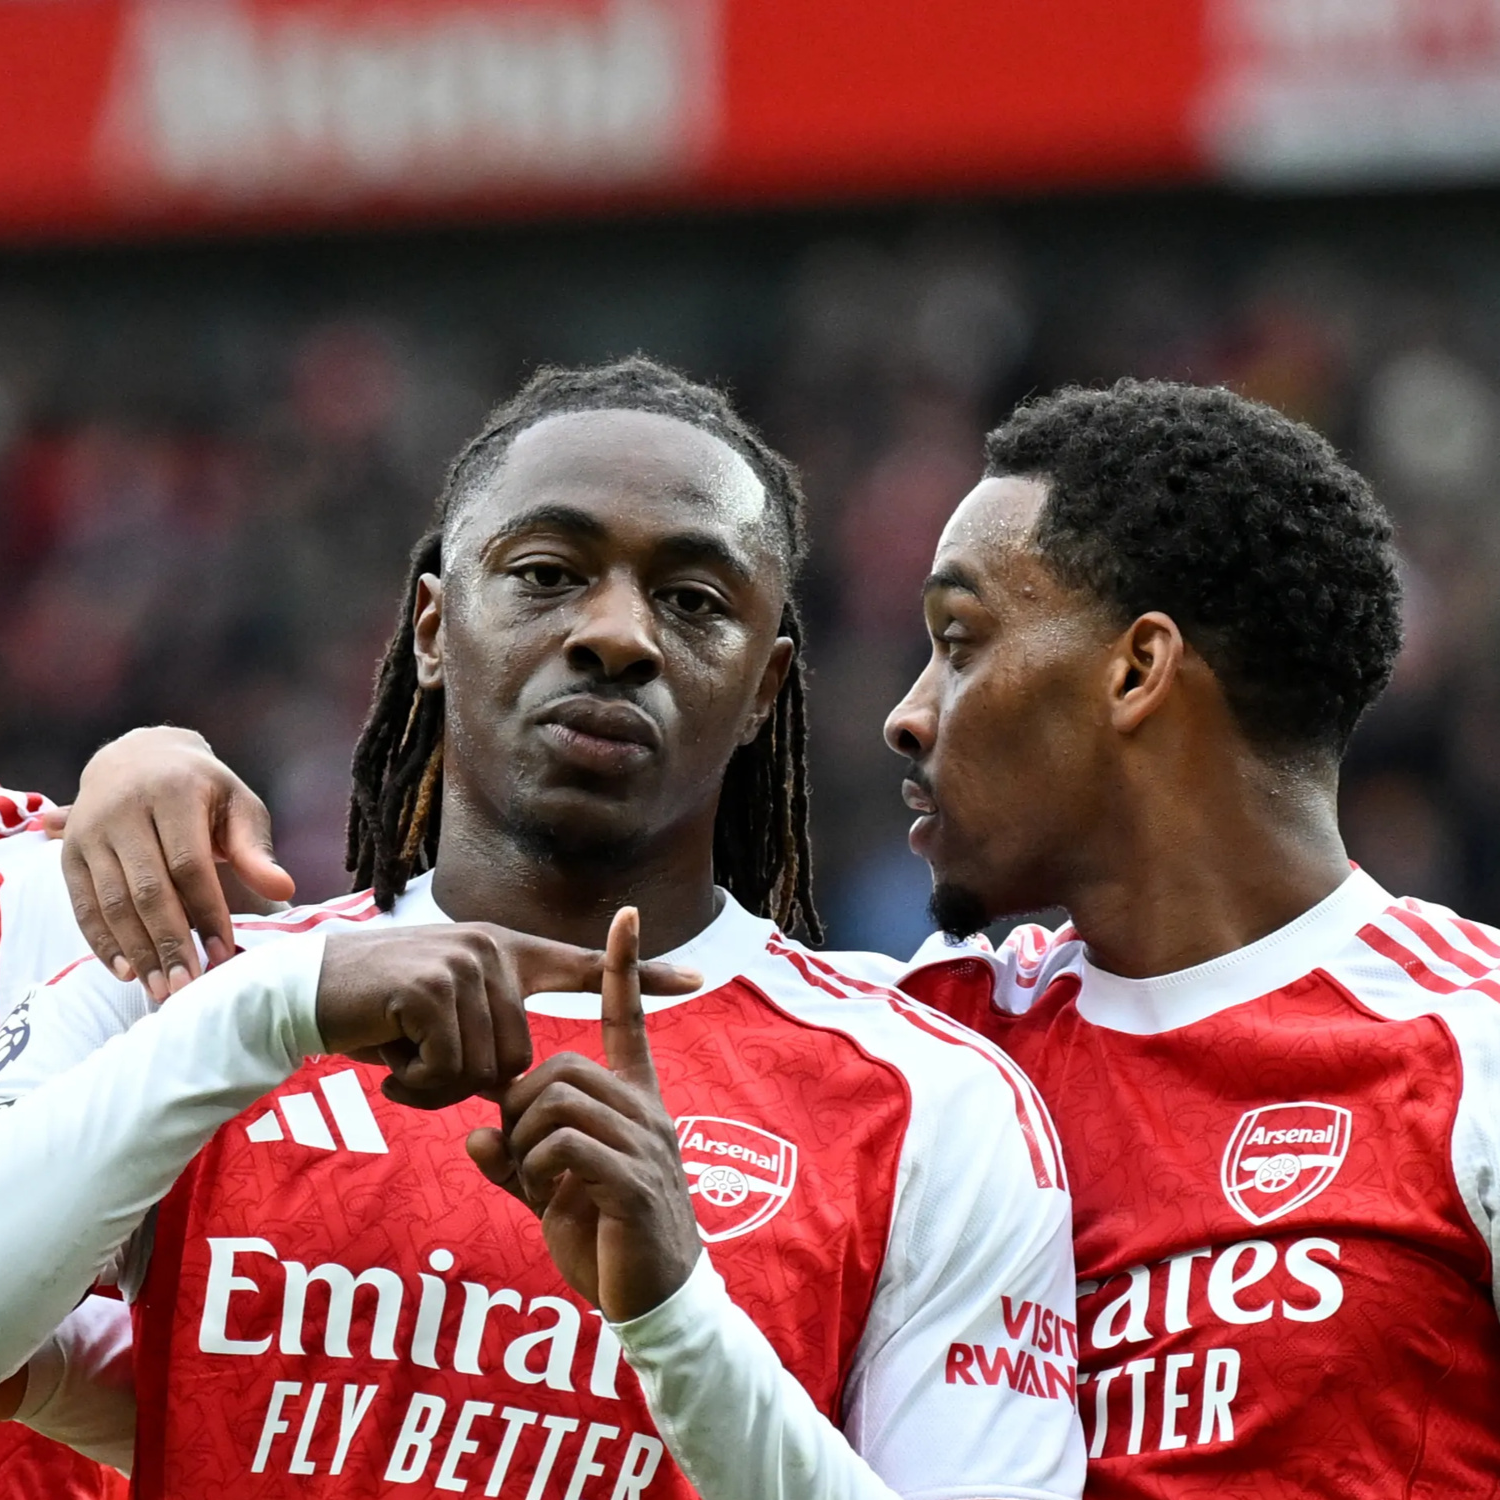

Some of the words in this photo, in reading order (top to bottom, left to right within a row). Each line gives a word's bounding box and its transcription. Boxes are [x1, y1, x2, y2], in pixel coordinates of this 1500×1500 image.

[684, 1132, 779, 1172] Arsenal
[1246, 1124, 1334, 1145] Arsenal
[251, 1380, 379, 1476] FLY
[1077, 1348, 1241, 1459] TTER
